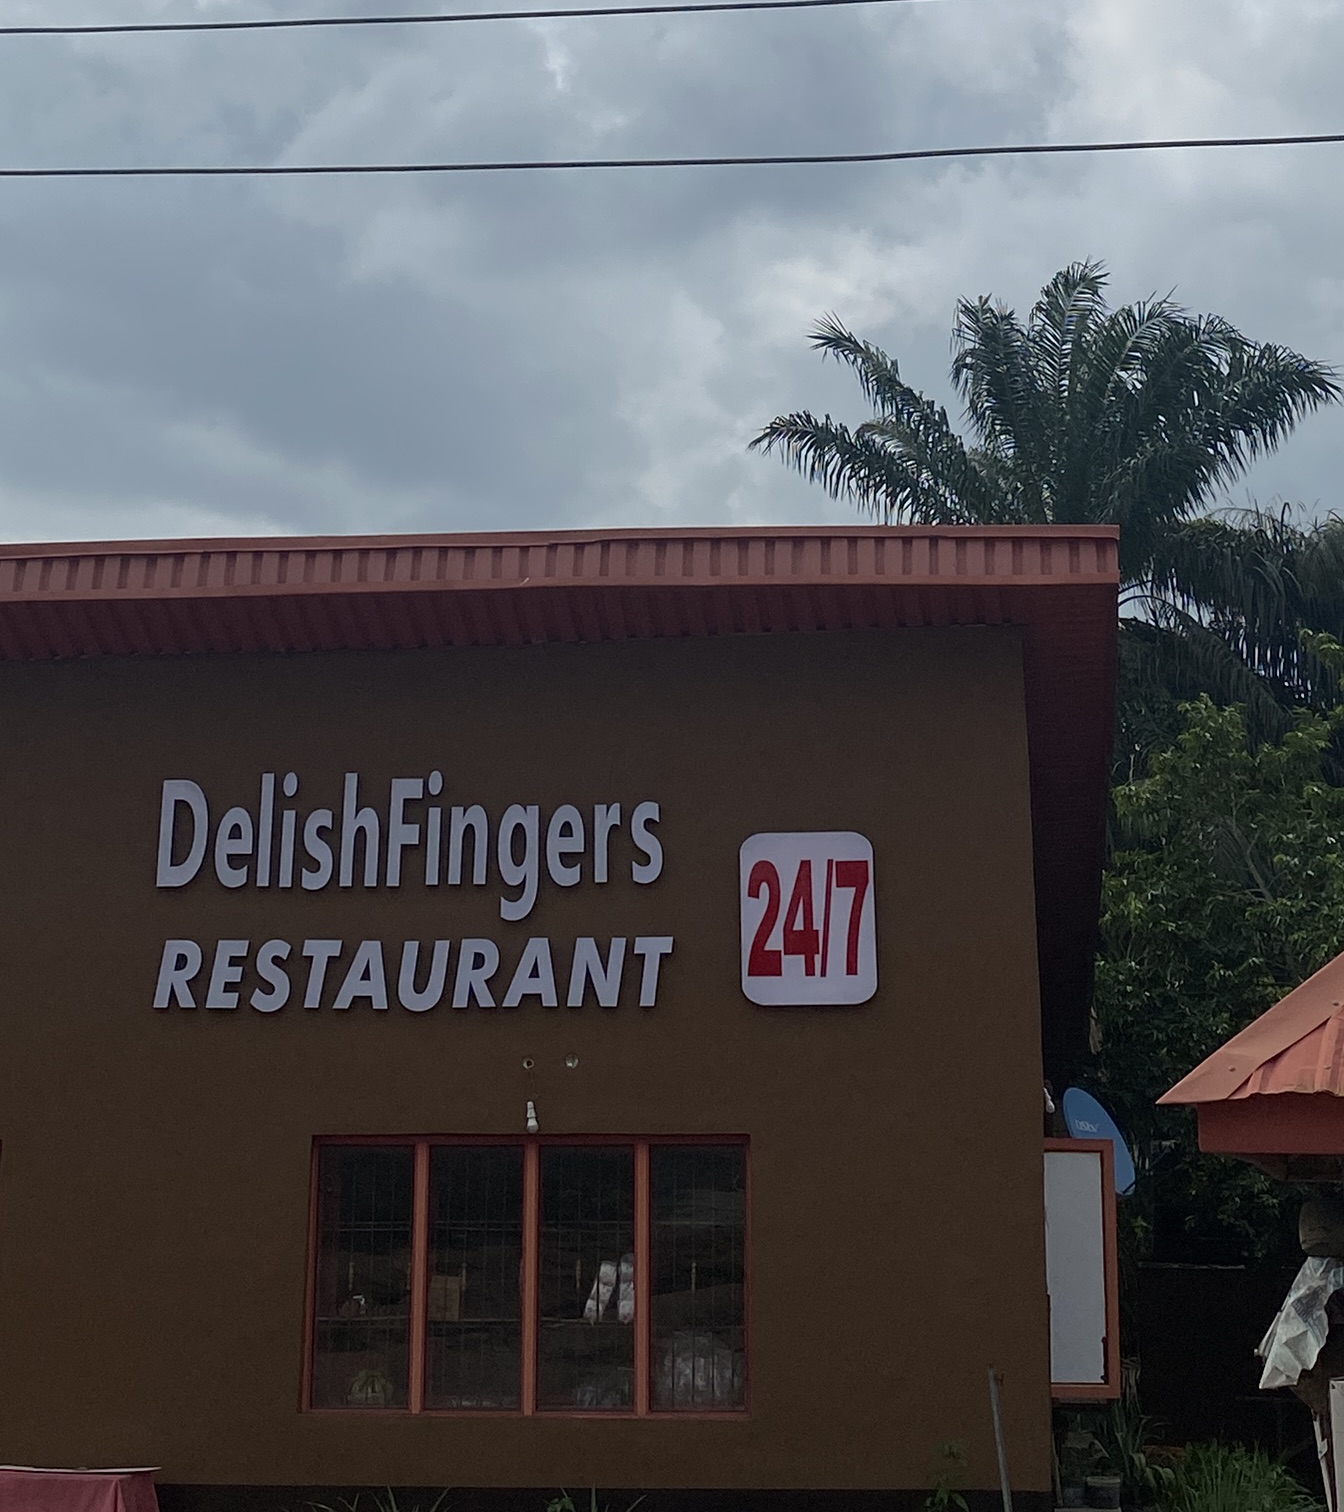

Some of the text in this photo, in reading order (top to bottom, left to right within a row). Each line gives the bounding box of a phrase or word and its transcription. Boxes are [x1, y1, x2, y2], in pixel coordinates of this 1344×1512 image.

[156, 770, 663, 921] DelishFingers
[153, 936, 674, 1011] RESTAURANT
[747, 859, 869, 977] 24/7
